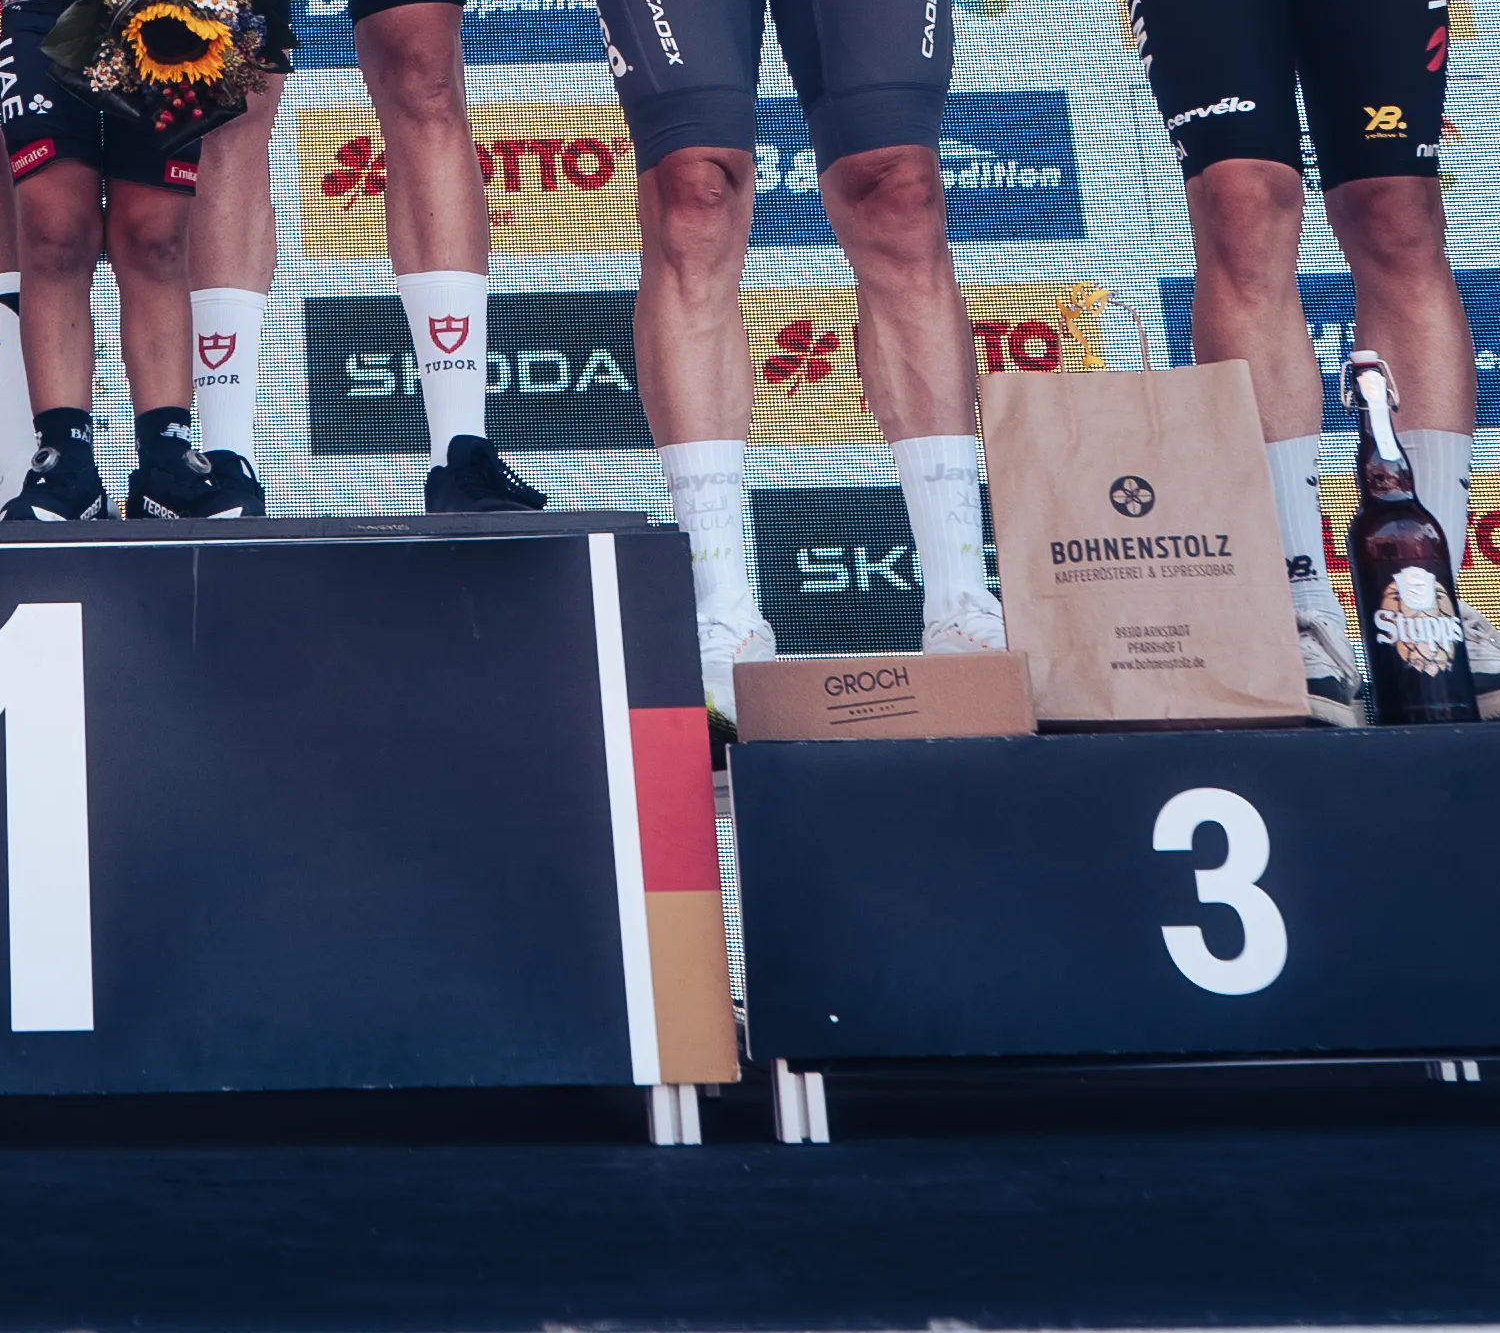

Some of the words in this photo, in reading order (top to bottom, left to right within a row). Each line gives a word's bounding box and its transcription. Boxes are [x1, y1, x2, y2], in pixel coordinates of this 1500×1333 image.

[1167, 96, 1256, 131] cervélo
[11, 144, 49, 173] Emirates
[170, 165, 198, 182] Emira
[425, 358, 478, 375] TUDOR
[923, 463, 980, 485] Jay
[1051, 534, 1231, 566] BOHNENSTOLZ
[1054, 567, 1143, 584] KAFFEERÖSTEREI
[1147, 566, 1157, 579] &
[1161, 563, 1236, 580] ESPRESSOBAR
[1143, 625, 1190, 639] ARNSTADT
[1375, 607, 1465, 648] Stupps
[1128, 642, 1177, 654] PFARRHOF
[824, 667, 910, 697] GROCH
[1152, 787, 1288, 996] 3
